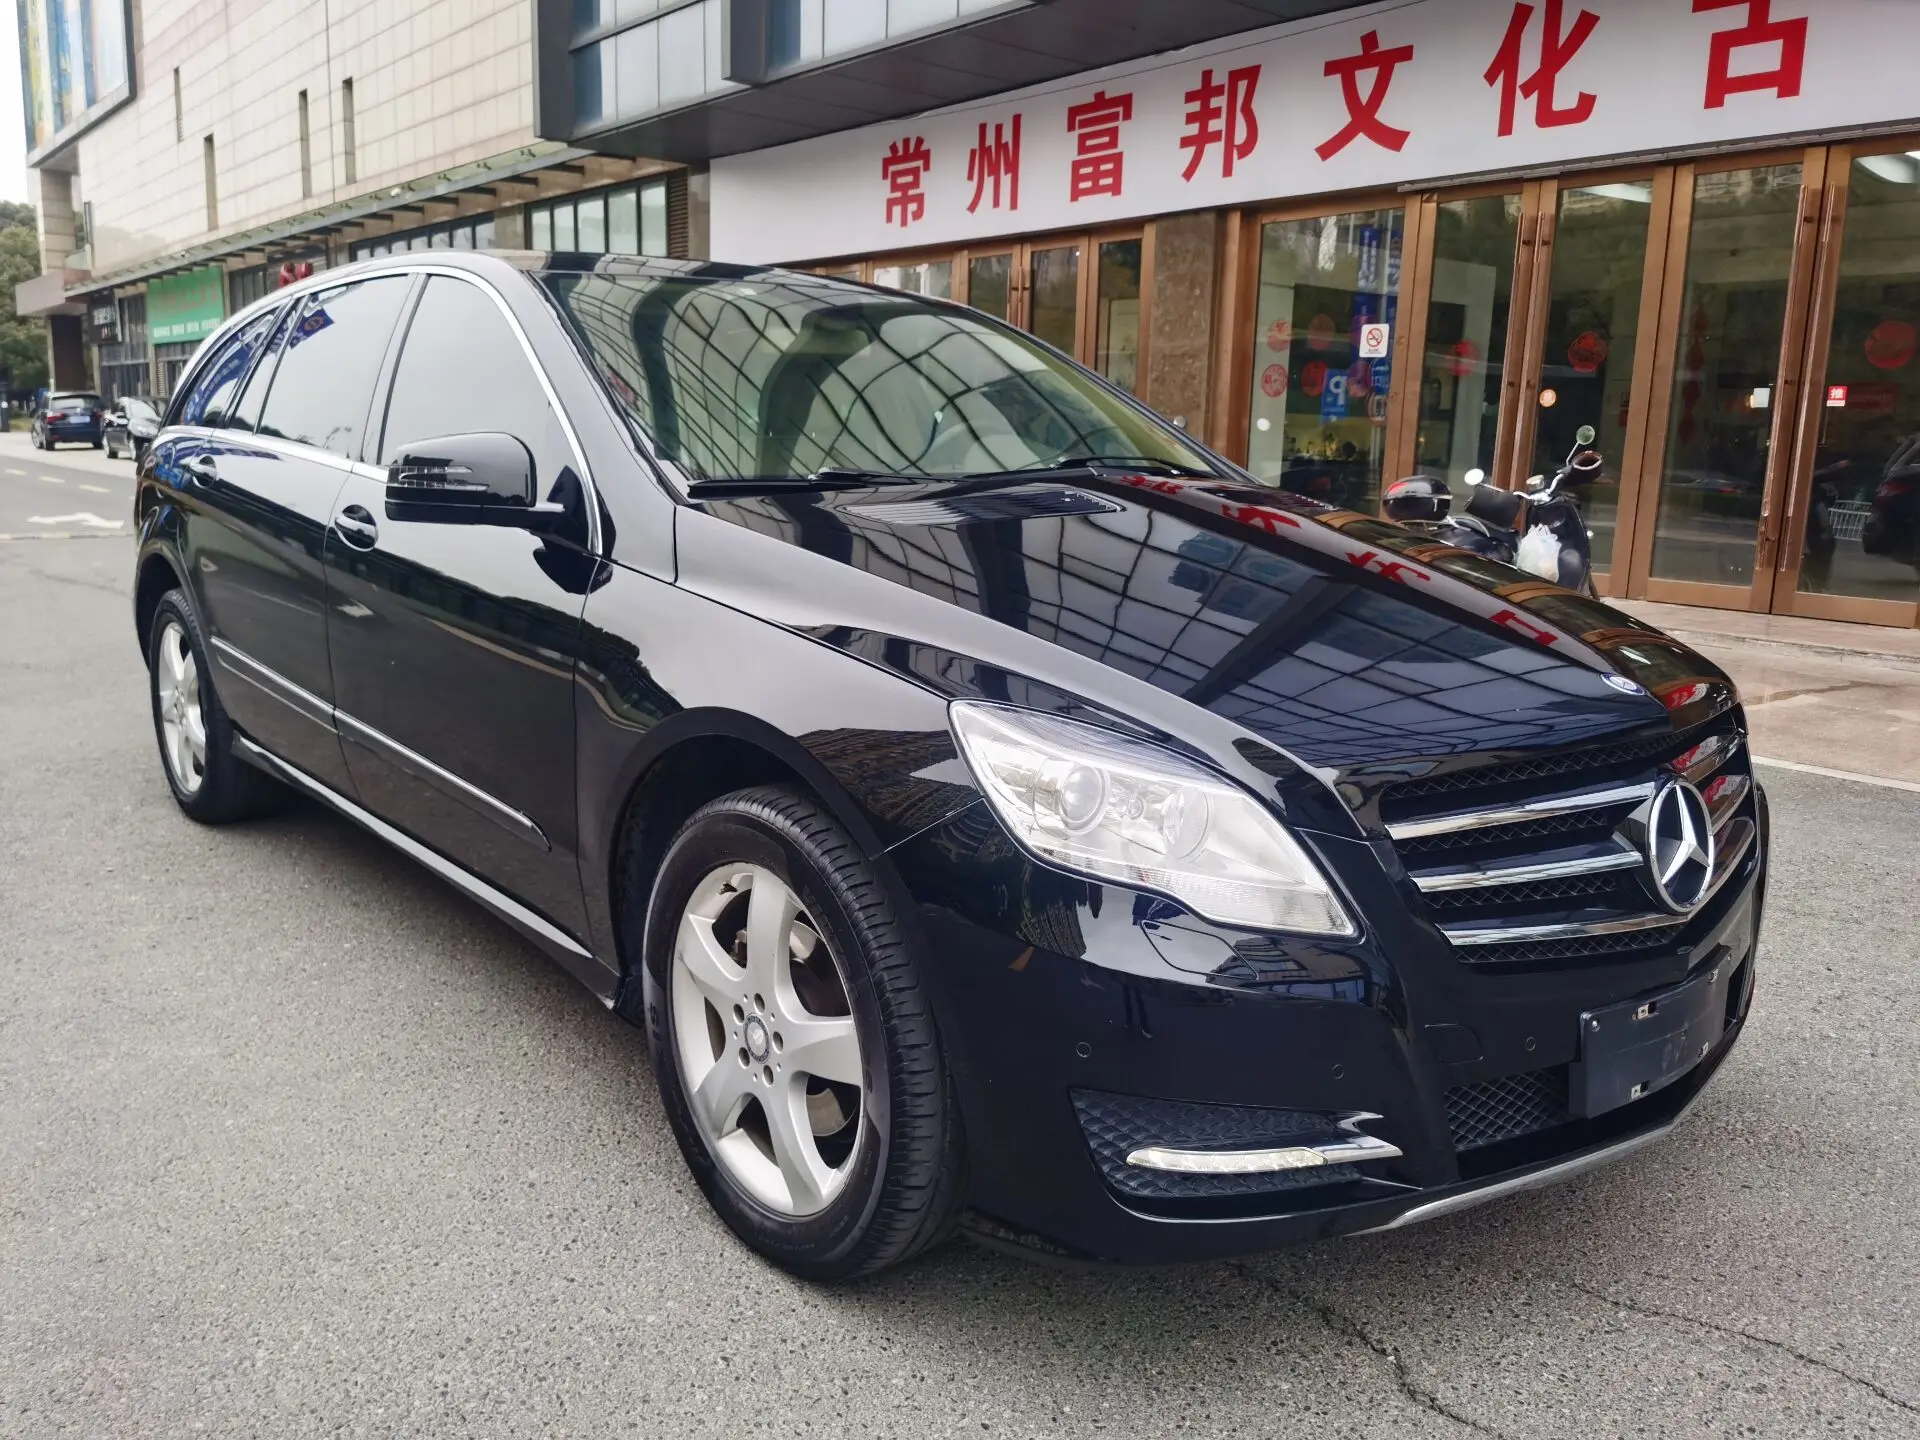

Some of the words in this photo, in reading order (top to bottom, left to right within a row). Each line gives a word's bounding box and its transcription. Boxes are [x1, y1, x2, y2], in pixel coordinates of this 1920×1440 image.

[881, 0, 1808, 228] 常州富邦文化古
